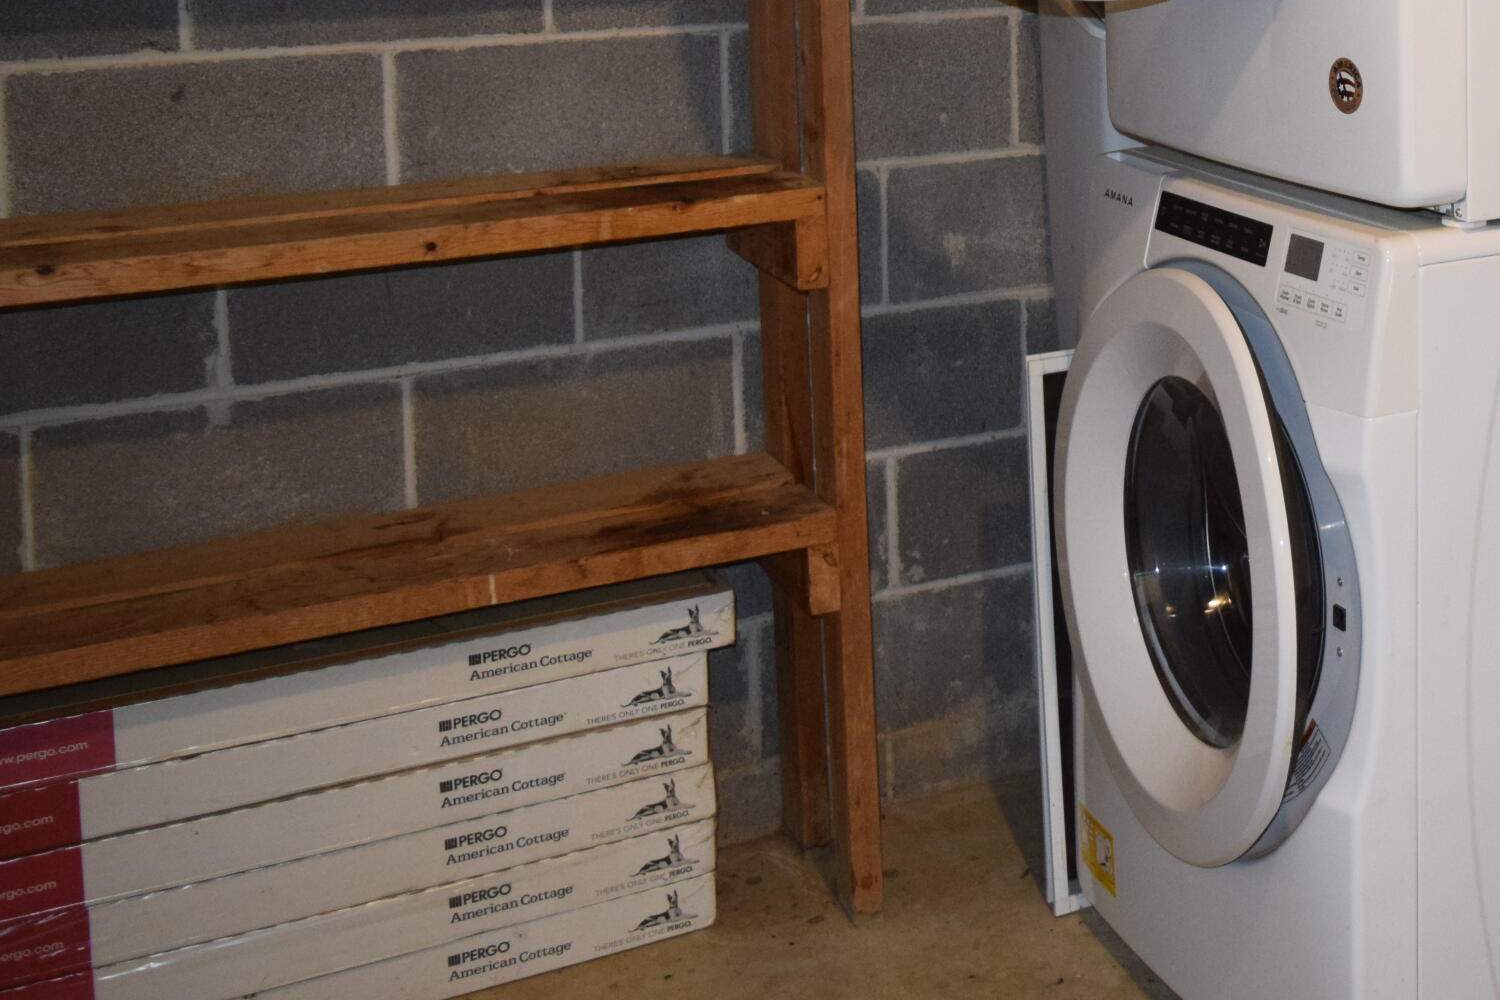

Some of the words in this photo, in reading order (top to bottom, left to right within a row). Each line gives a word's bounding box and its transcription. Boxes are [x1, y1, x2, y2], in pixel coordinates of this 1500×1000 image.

[1103, 188, 1134, 207] AMANA
[470, 658, 538, 681] American
[539, 650, 593, 668] Cottage
[482, 643, 532, 664] PERGO
[440, 723, 509, 747] American
[510, 713, 564, 733] Cottage
[452, 708, 502, 730] PERGO
[0, 740, 89, 766] w.pergo.com
[440, 784, 510, 808] American
[511, 772, 566, 792] Cottage
[453, 768, 503, 790] PERGO
[446, 842, 514, 866] American
[515, 827, 570, 850] Cottage
[458, 825, 508, 848] PERGO
[450, 900, 518, 924] American
[519, 885, 574, 907] Cottage
[462, 882, 512, 906] PERGO
[449, 958, 517, 982] American
[518, 942, 572, 964] Cottage
[462, 940, 510, 963] PERGO
